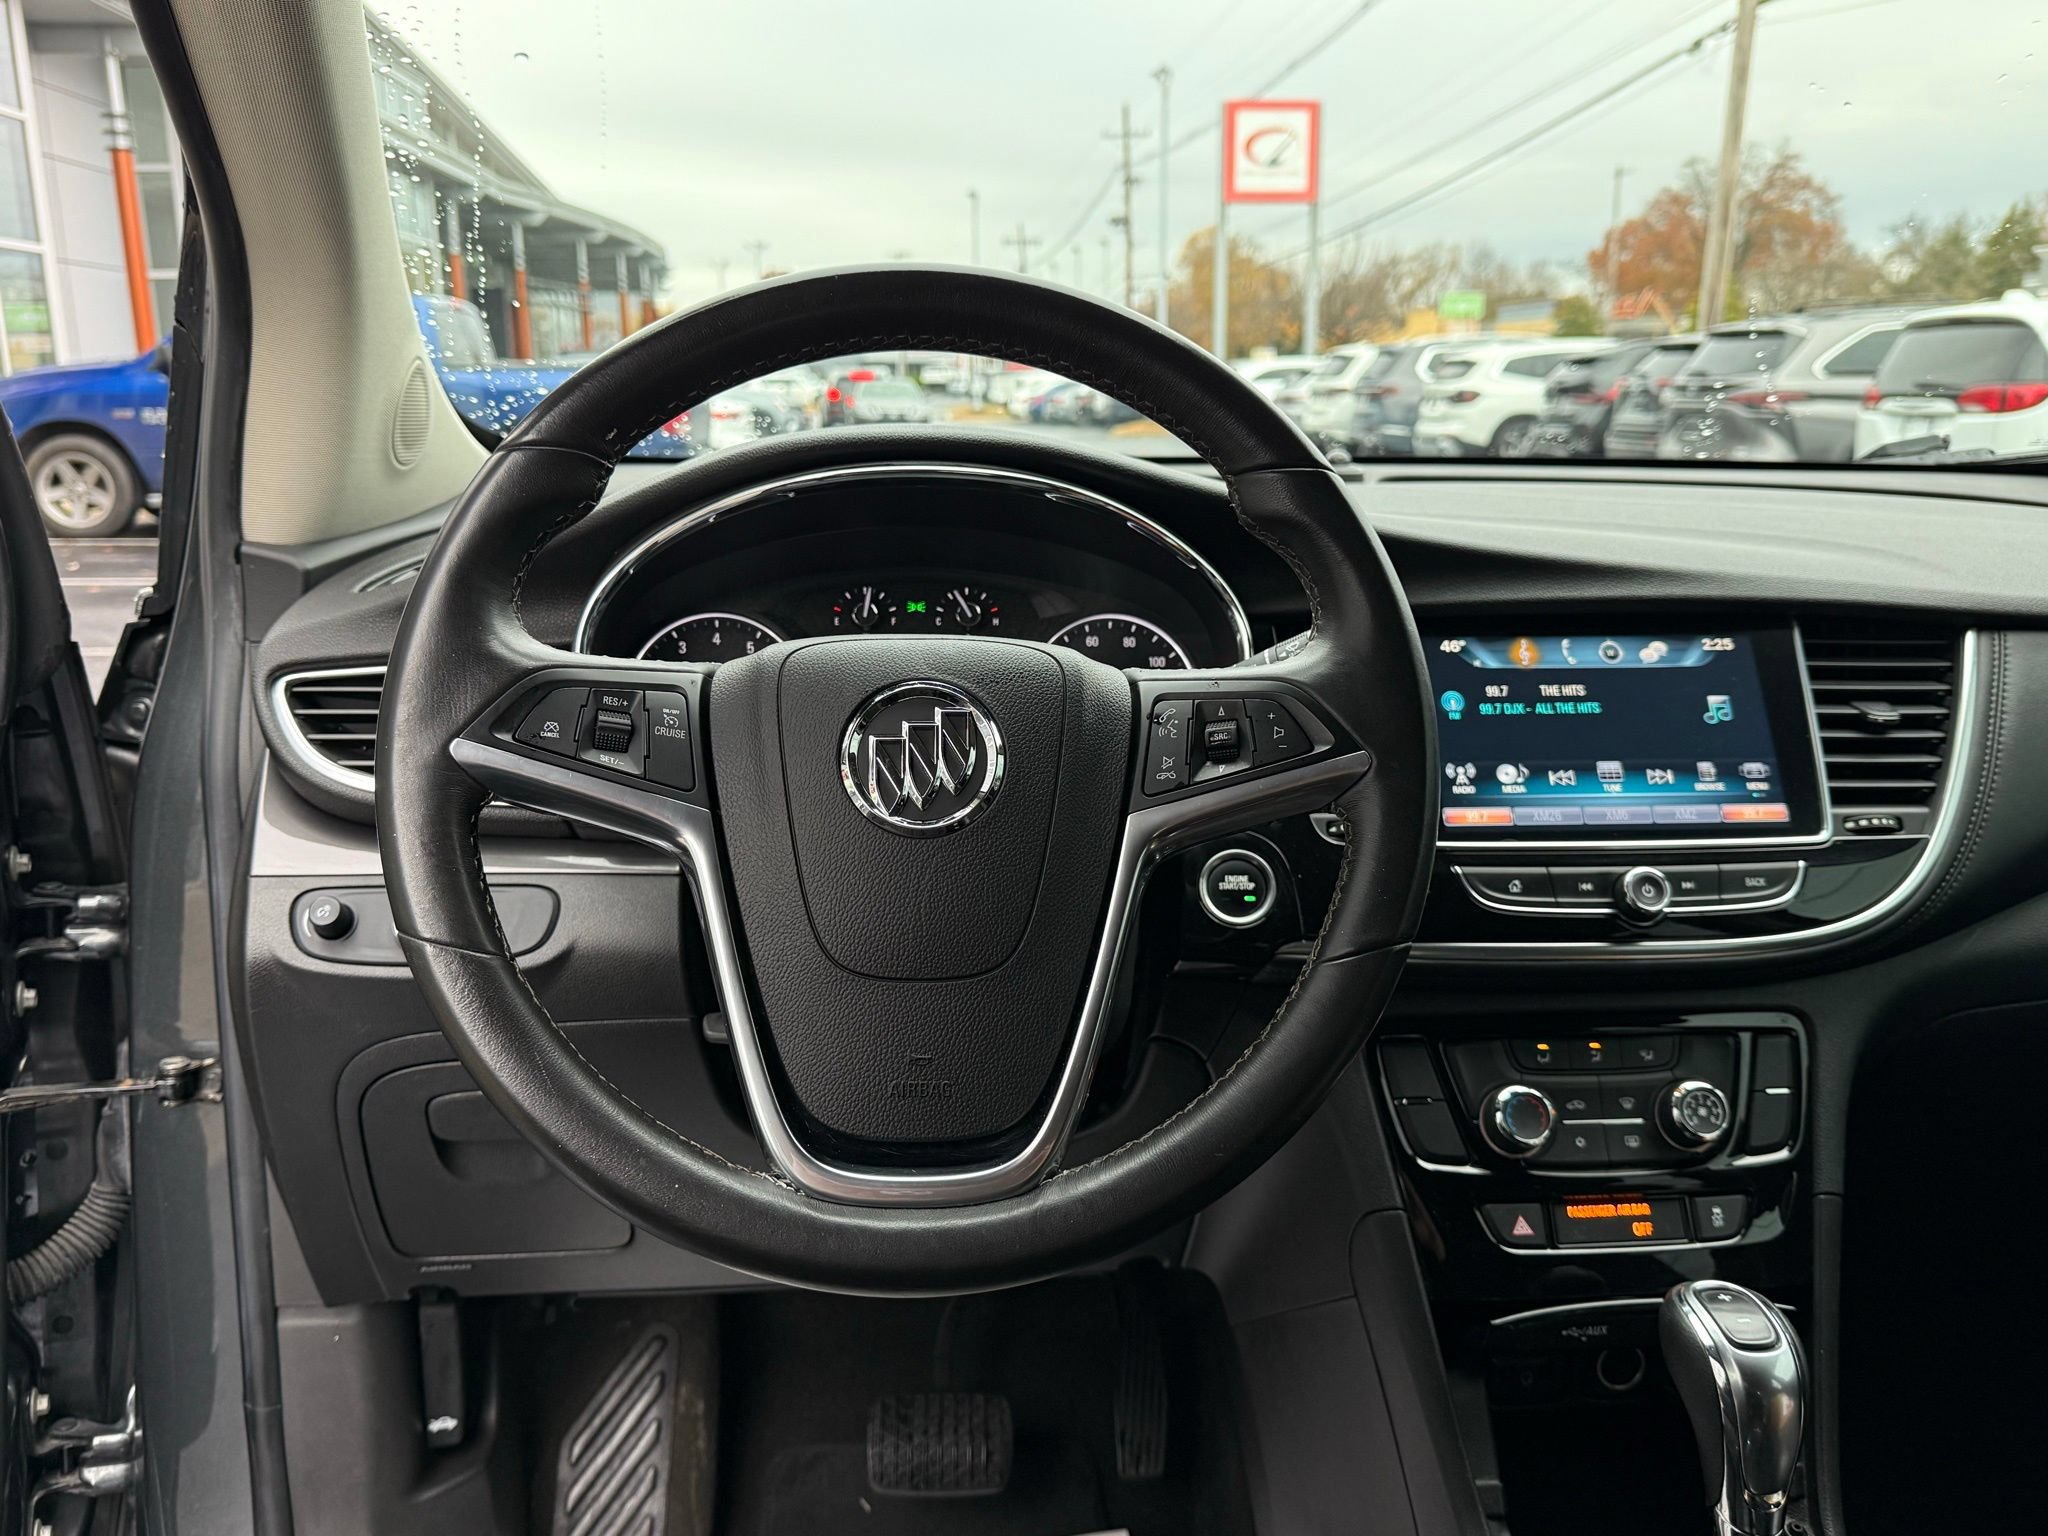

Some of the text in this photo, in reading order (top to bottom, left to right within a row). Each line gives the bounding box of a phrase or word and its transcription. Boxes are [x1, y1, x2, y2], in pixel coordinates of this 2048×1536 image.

[712, 632, 721, 645] 4
[1085, 635, 1099, 648] 60
[1123, 635, 1136, 648] 80
[678, 641, 687, 654] 3
[1149, 656, 1166, 668] 100
[1485, 684, 1587, 697] 99.7 THE HITS
[1479, 703, 1502, 715] 99.7
[1504, 703, 1526, 715] DJX
[1535, 703, 1555, 714] ALL
[1555, 703, 1576, 714] THE
[1577, 702, 1602, 714] HITS
[654, 726, 686, 739] CRUISE
[889, 1080, 951, 1098] AIRBAG
